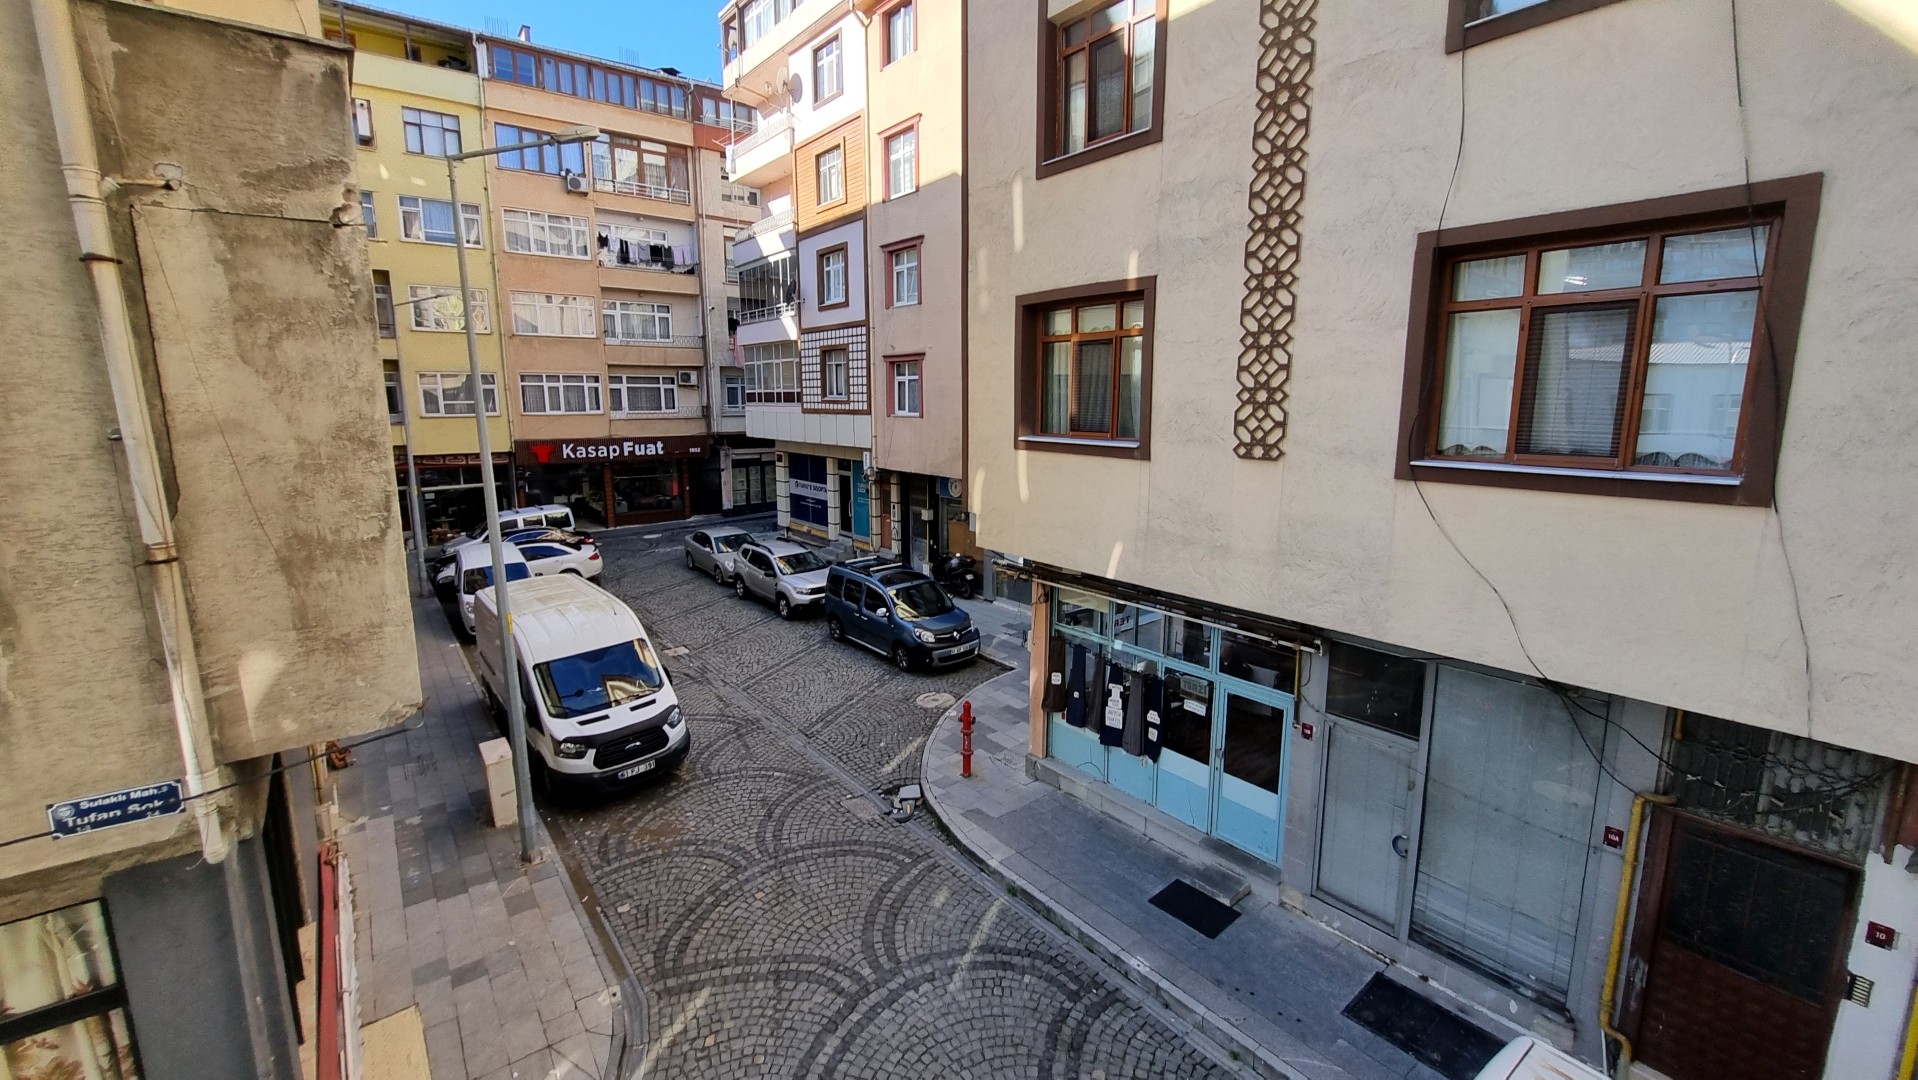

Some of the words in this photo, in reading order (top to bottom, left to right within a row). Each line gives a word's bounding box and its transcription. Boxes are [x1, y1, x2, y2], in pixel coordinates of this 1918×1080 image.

[562, 442, 620, 459] Kasap
[623, 441, 664, 456] Fuat
[64, 809, 122, 827] Tufan
[1607, 833, 1620, 843] 10A
[1875, 931, 1886, 941] 10
